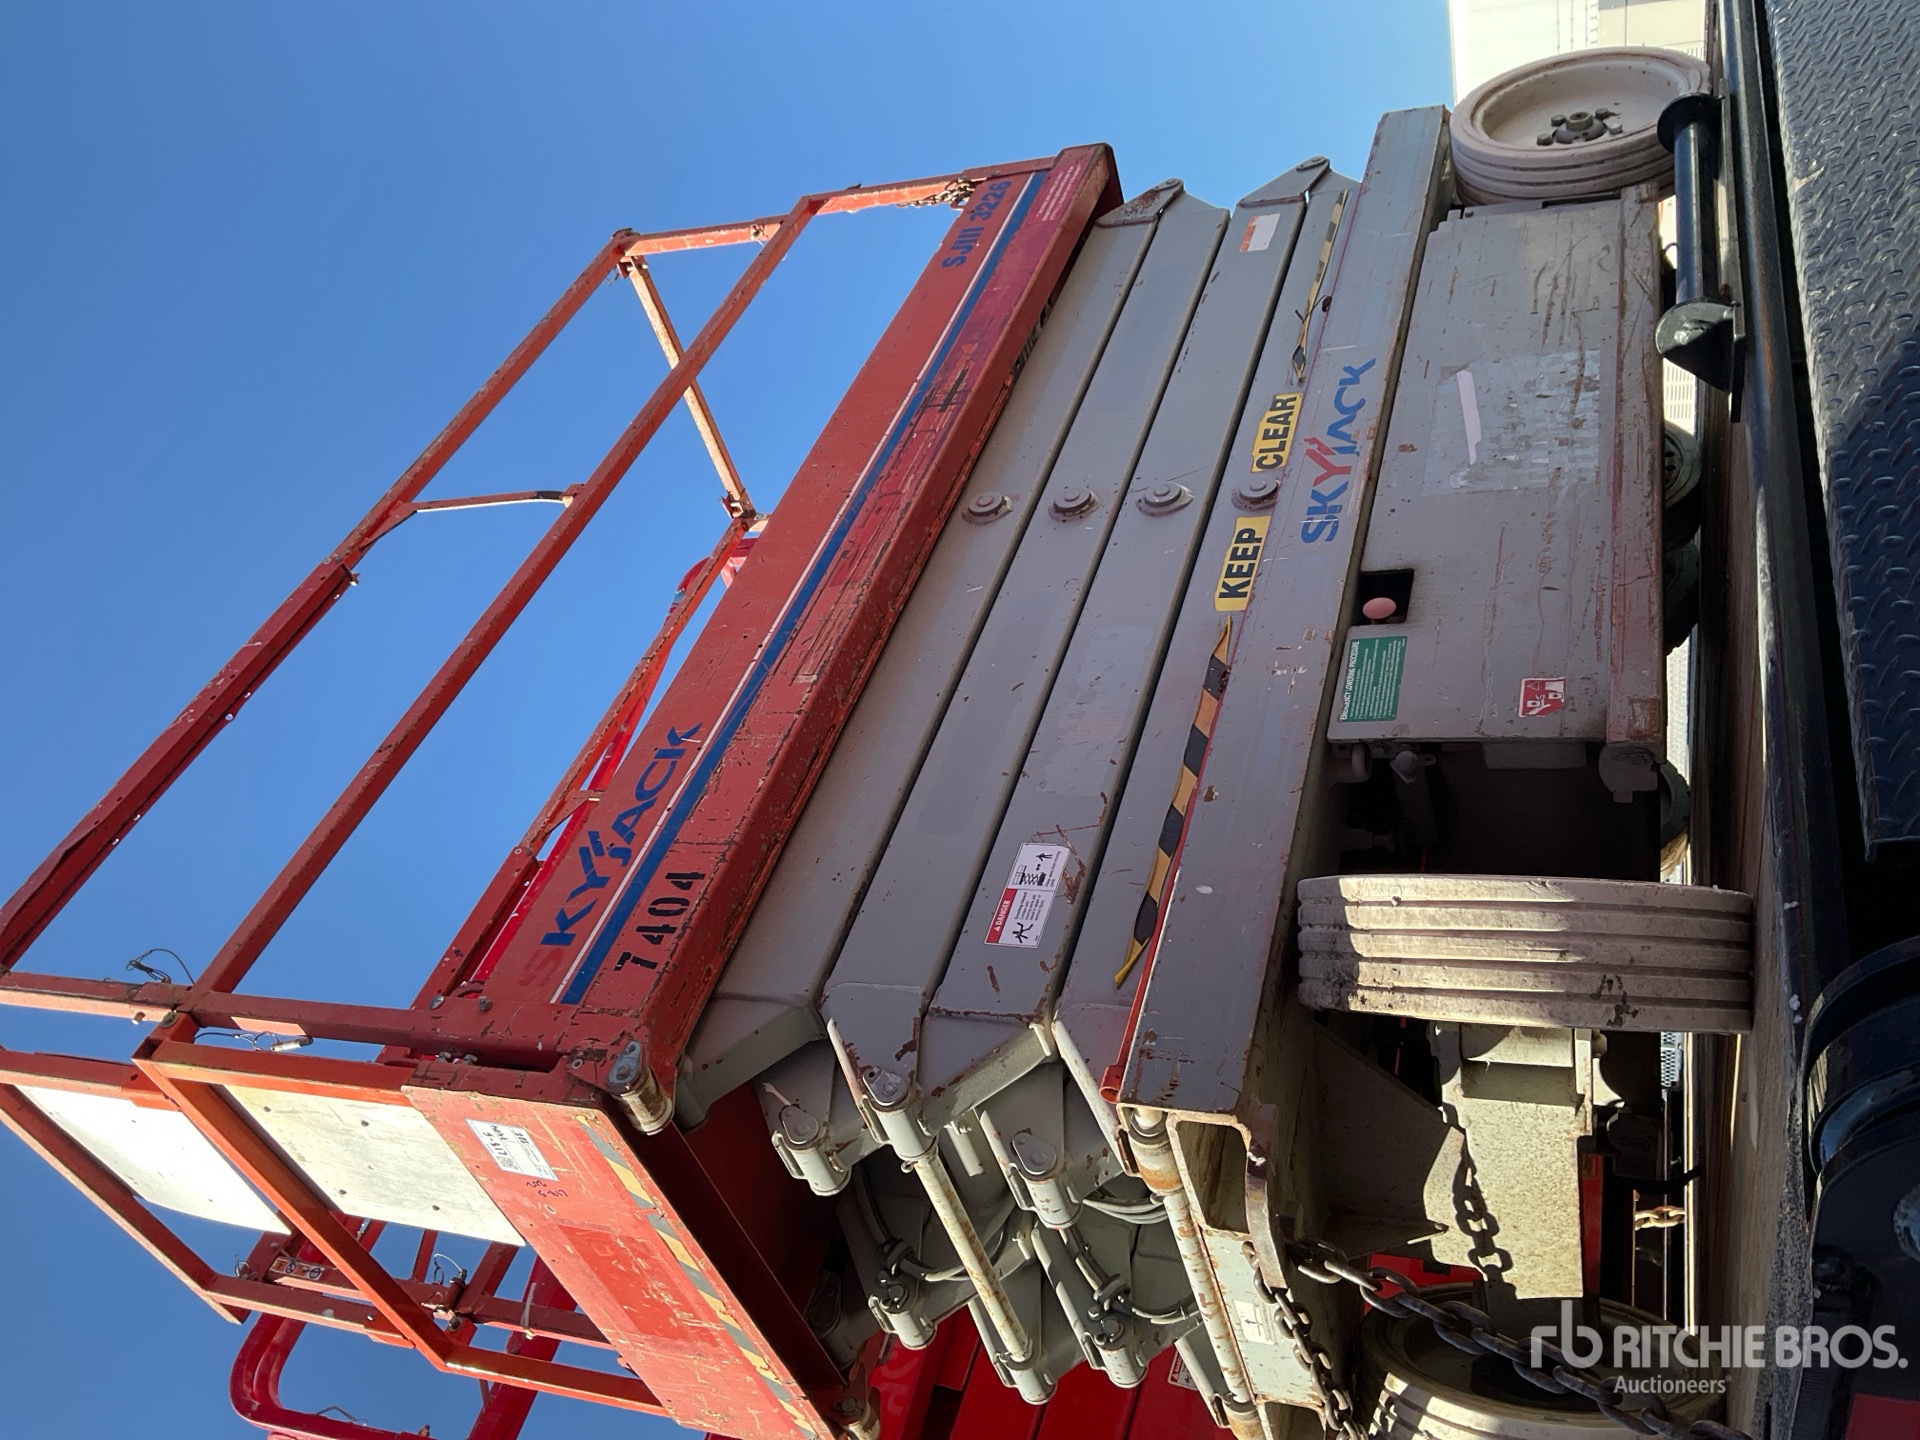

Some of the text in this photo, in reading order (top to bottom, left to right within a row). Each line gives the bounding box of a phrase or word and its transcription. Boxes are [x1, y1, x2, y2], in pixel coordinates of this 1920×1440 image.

[970, 180, 1013, 221] 3226
[1301, 358, 1377, 543] SKYJACK
[1218, 396, 1297, 599] KEEP CLEAR
[1348, 641, 1360, 668] PROCEDURE
[1345, 667, 1356, 692] LOWERING
[613, 871, 706, 971] 7404
[994, 900, 1011, 925] DANGER
